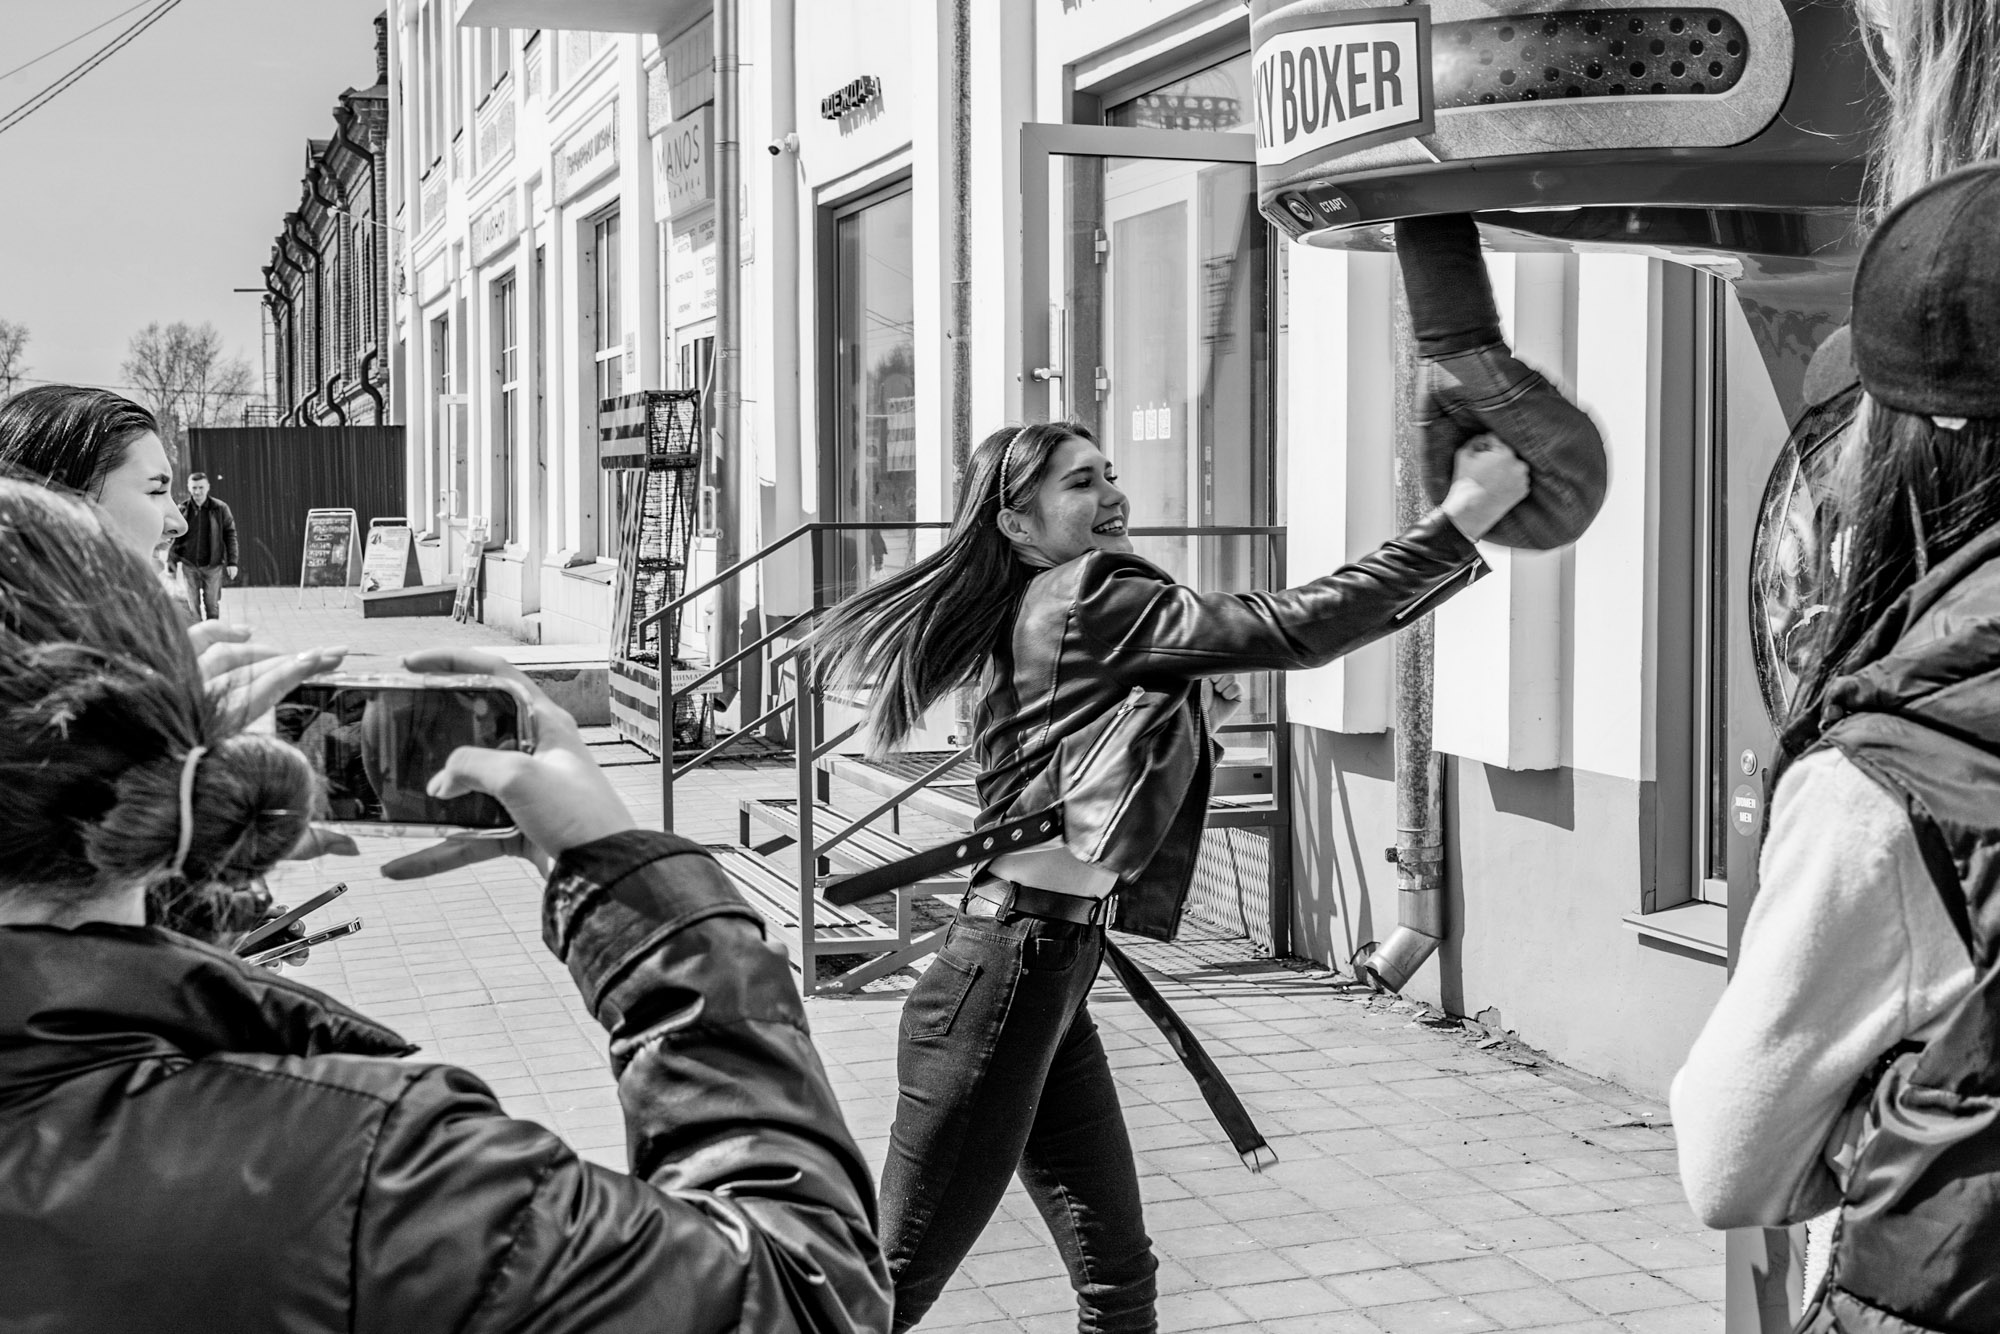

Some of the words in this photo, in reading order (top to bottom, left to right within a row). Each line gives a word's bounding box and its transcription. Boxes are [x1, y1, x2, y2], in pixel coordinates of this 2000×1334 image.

[1254, 54, 1274, 149] KY
[1280, 41, 1403, 144] BOXER
[657, 124, 700, 184] MANOS
[1319, 197, 1347, 213] СТАРТ
